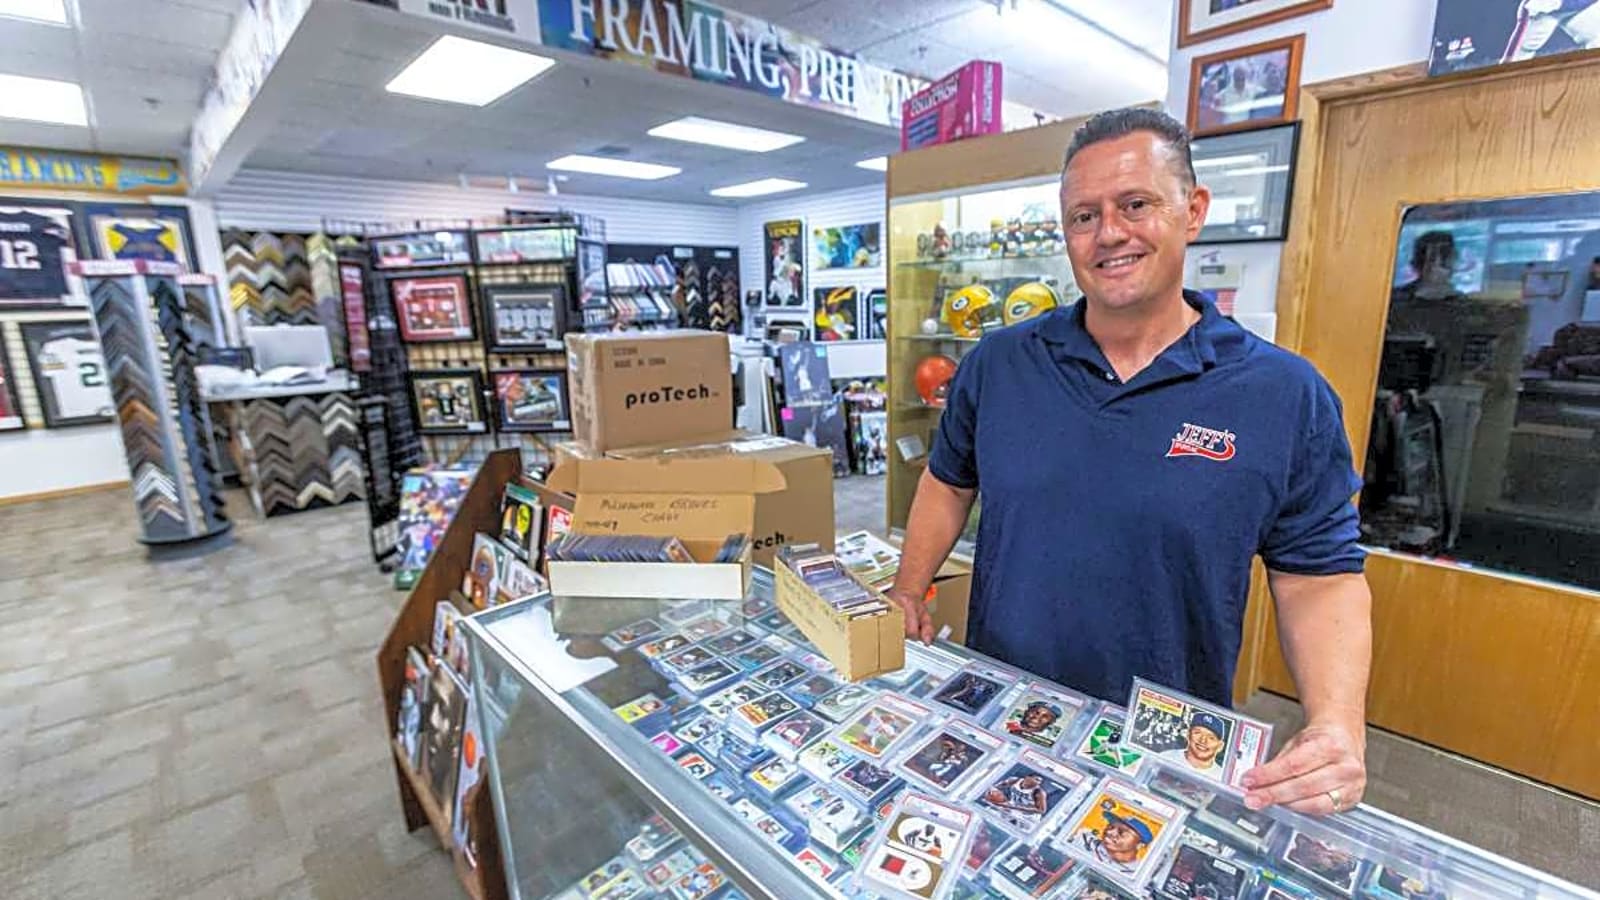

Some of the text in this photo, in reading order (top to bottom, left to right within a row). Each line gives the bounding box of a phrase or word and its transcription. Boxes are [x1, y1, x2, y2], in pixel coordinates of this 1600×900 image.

[0, 240, 42, 269] 12
[625, 383, 710, 410] proTech
[1175, 422, 1237, 457] JEFF'S
[751, 531, 785, 551] ech
